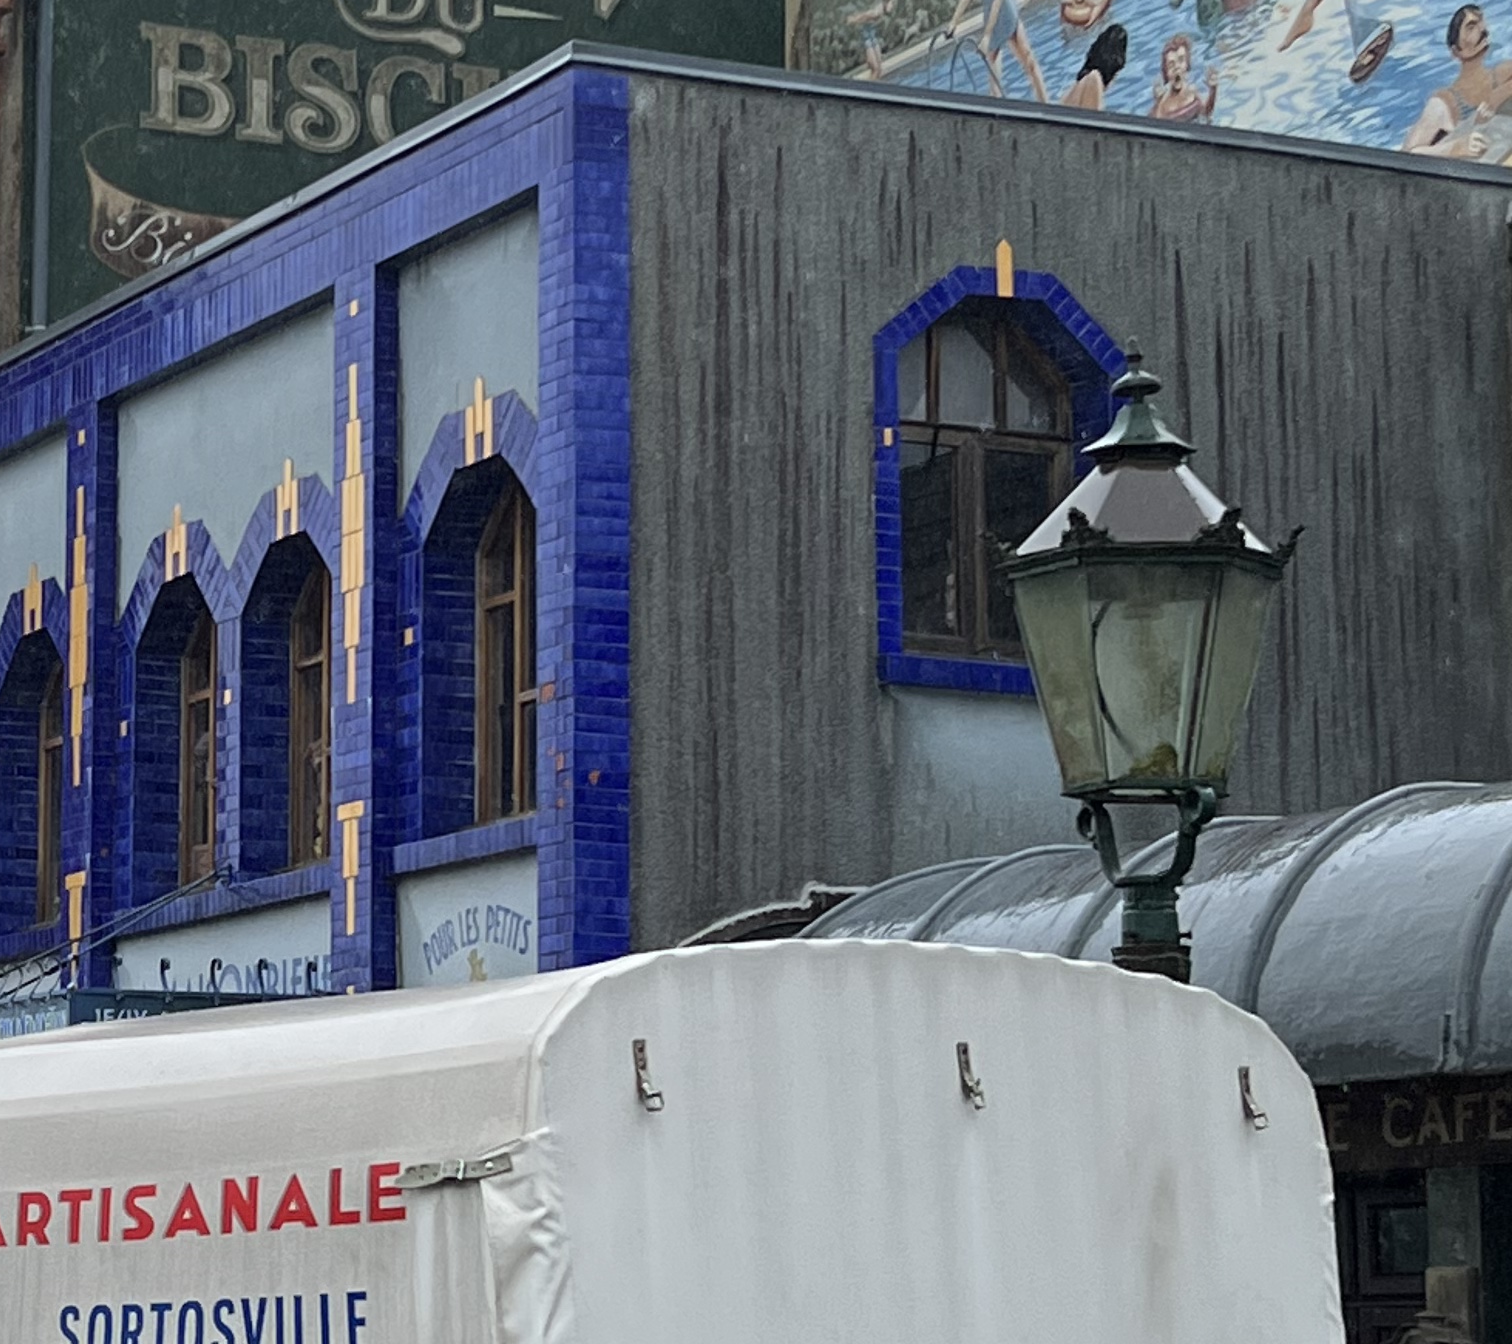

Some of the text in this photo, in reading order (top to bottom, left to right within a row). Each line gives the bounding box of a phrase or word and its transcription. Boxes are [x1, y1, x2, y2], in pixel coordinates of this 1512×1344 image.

[422, 904, 533, 976] POUR LES PETITS
[1324, 1103, 1351, 1152] E
